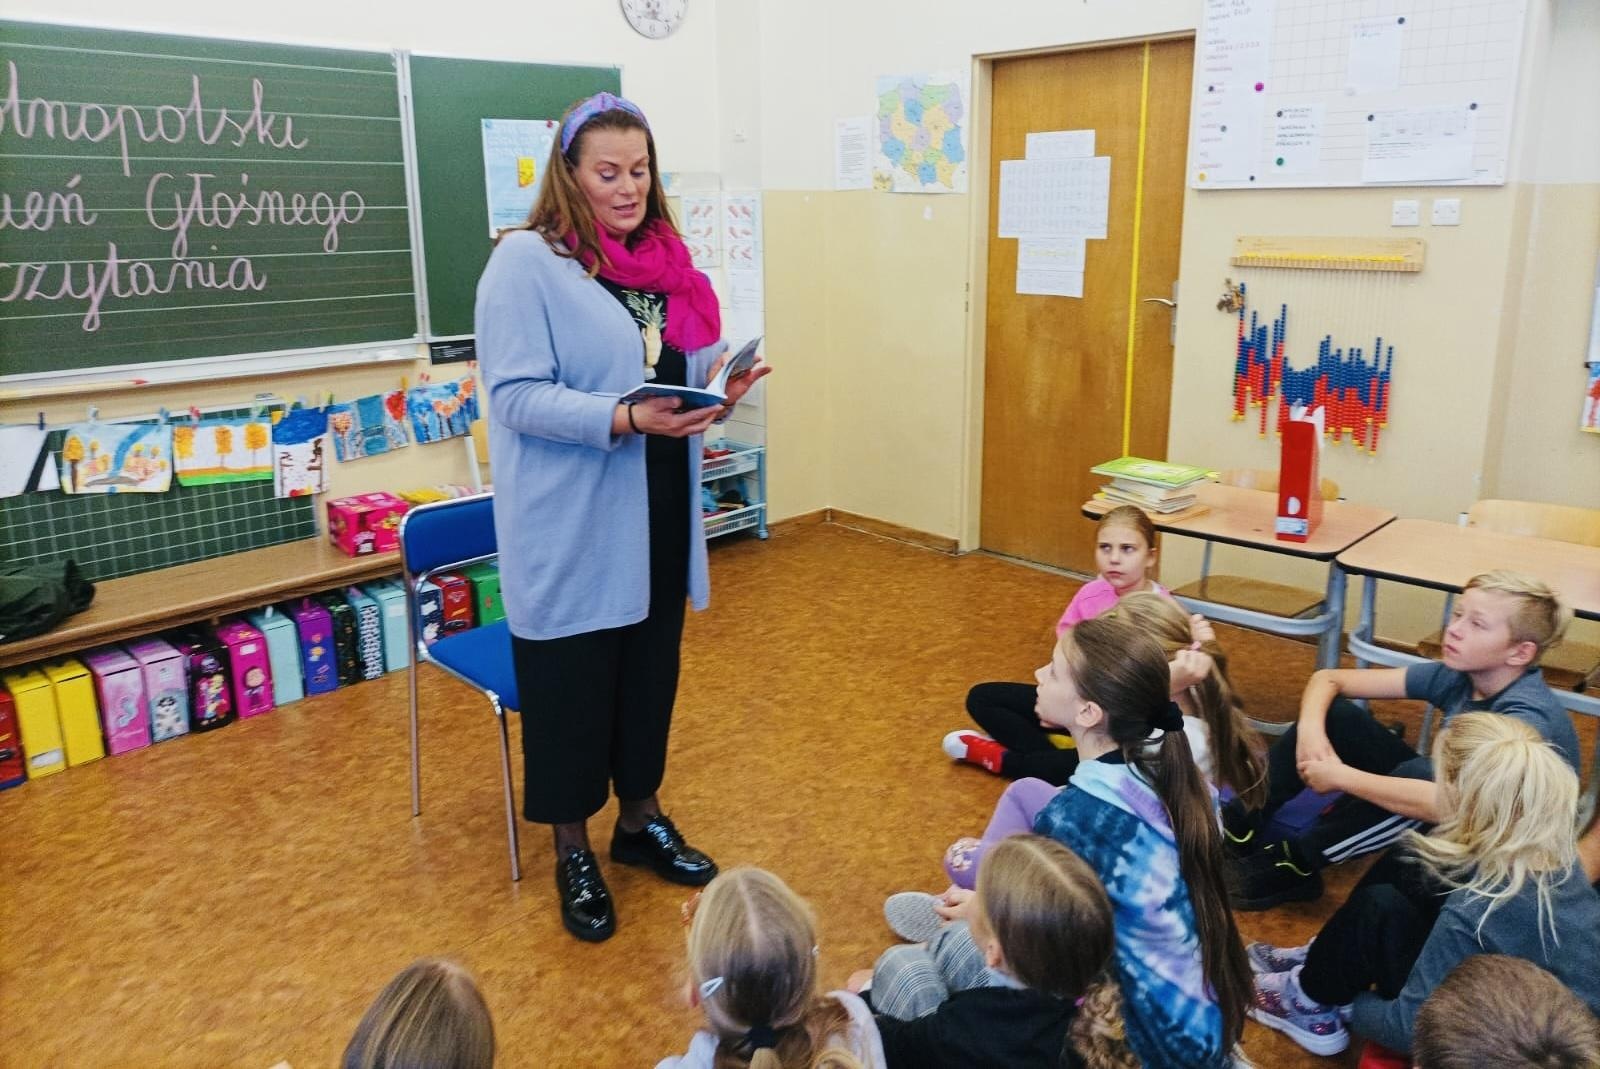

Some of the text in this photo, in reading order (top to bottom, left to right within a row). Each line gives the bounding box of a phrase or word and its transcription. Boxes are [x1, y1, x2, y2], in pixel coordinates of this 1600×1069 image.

[0, 60, 308, 177] lnopolski
[0, 172, 366, 260] ień Głośnego
